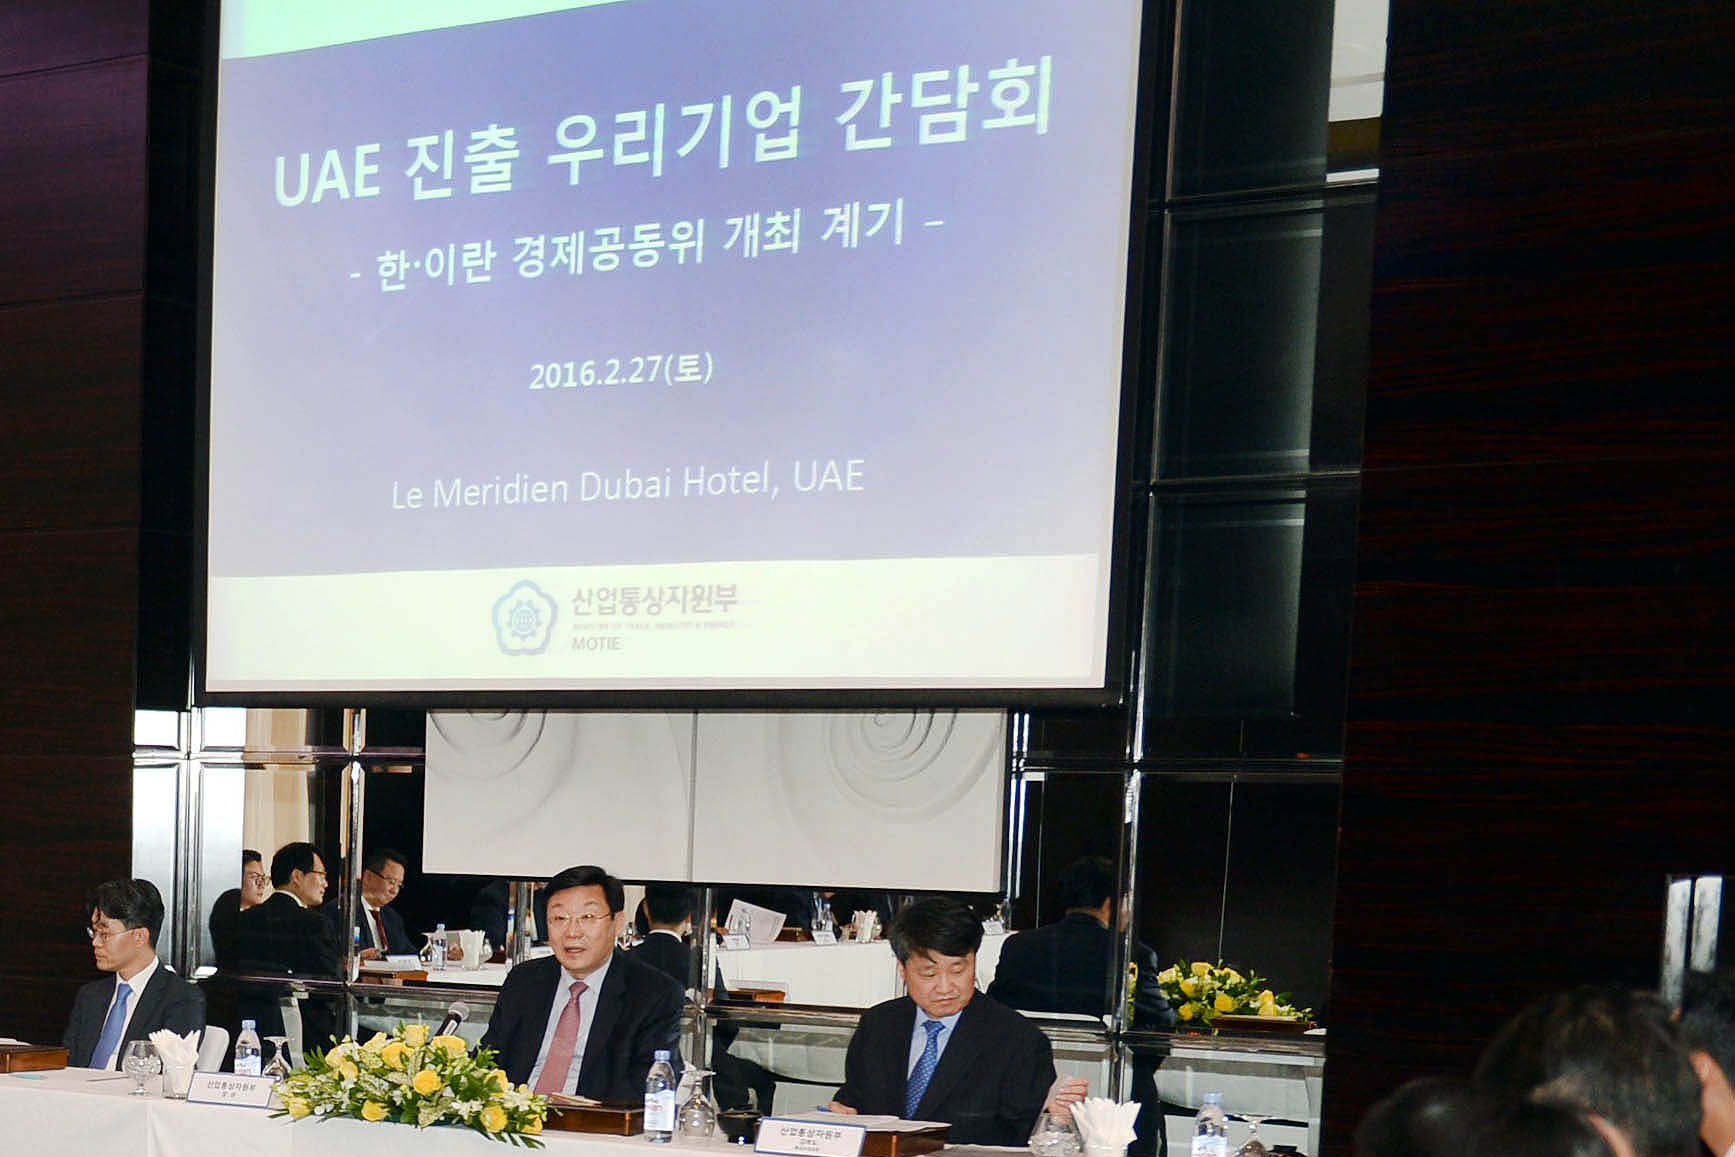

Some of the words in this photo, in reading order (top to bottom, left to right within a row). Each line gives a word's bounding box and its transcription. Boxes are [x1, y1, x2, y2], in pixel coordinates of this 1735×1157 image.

[275, 143, 382, 207] UAE
[405, 123, 521, 201] 진출
[547, 84, 802, 186] 우리기업
[835, 55, 1053, 151] 간담회
[376, 239, 498, 292] 한·이란
[512, 218, 706, 278] 경제공동위
[723, 207, 802, 258] 개최
[821, 197, 905, 249] 계기
[529, 351, 714, 390] 2016.2.27(토)
[392, 479, 423, 510] Le
[434, 473, 568, 507] Meridien
[581, 469, 671, 501] Dubai
[684, 460, 779, 498] Hotel,
[794, 459, 866, 493] UAE
[571, 583, 738, 617] 산업통상자원부
[571, 636, 622, 652] MOTIE
